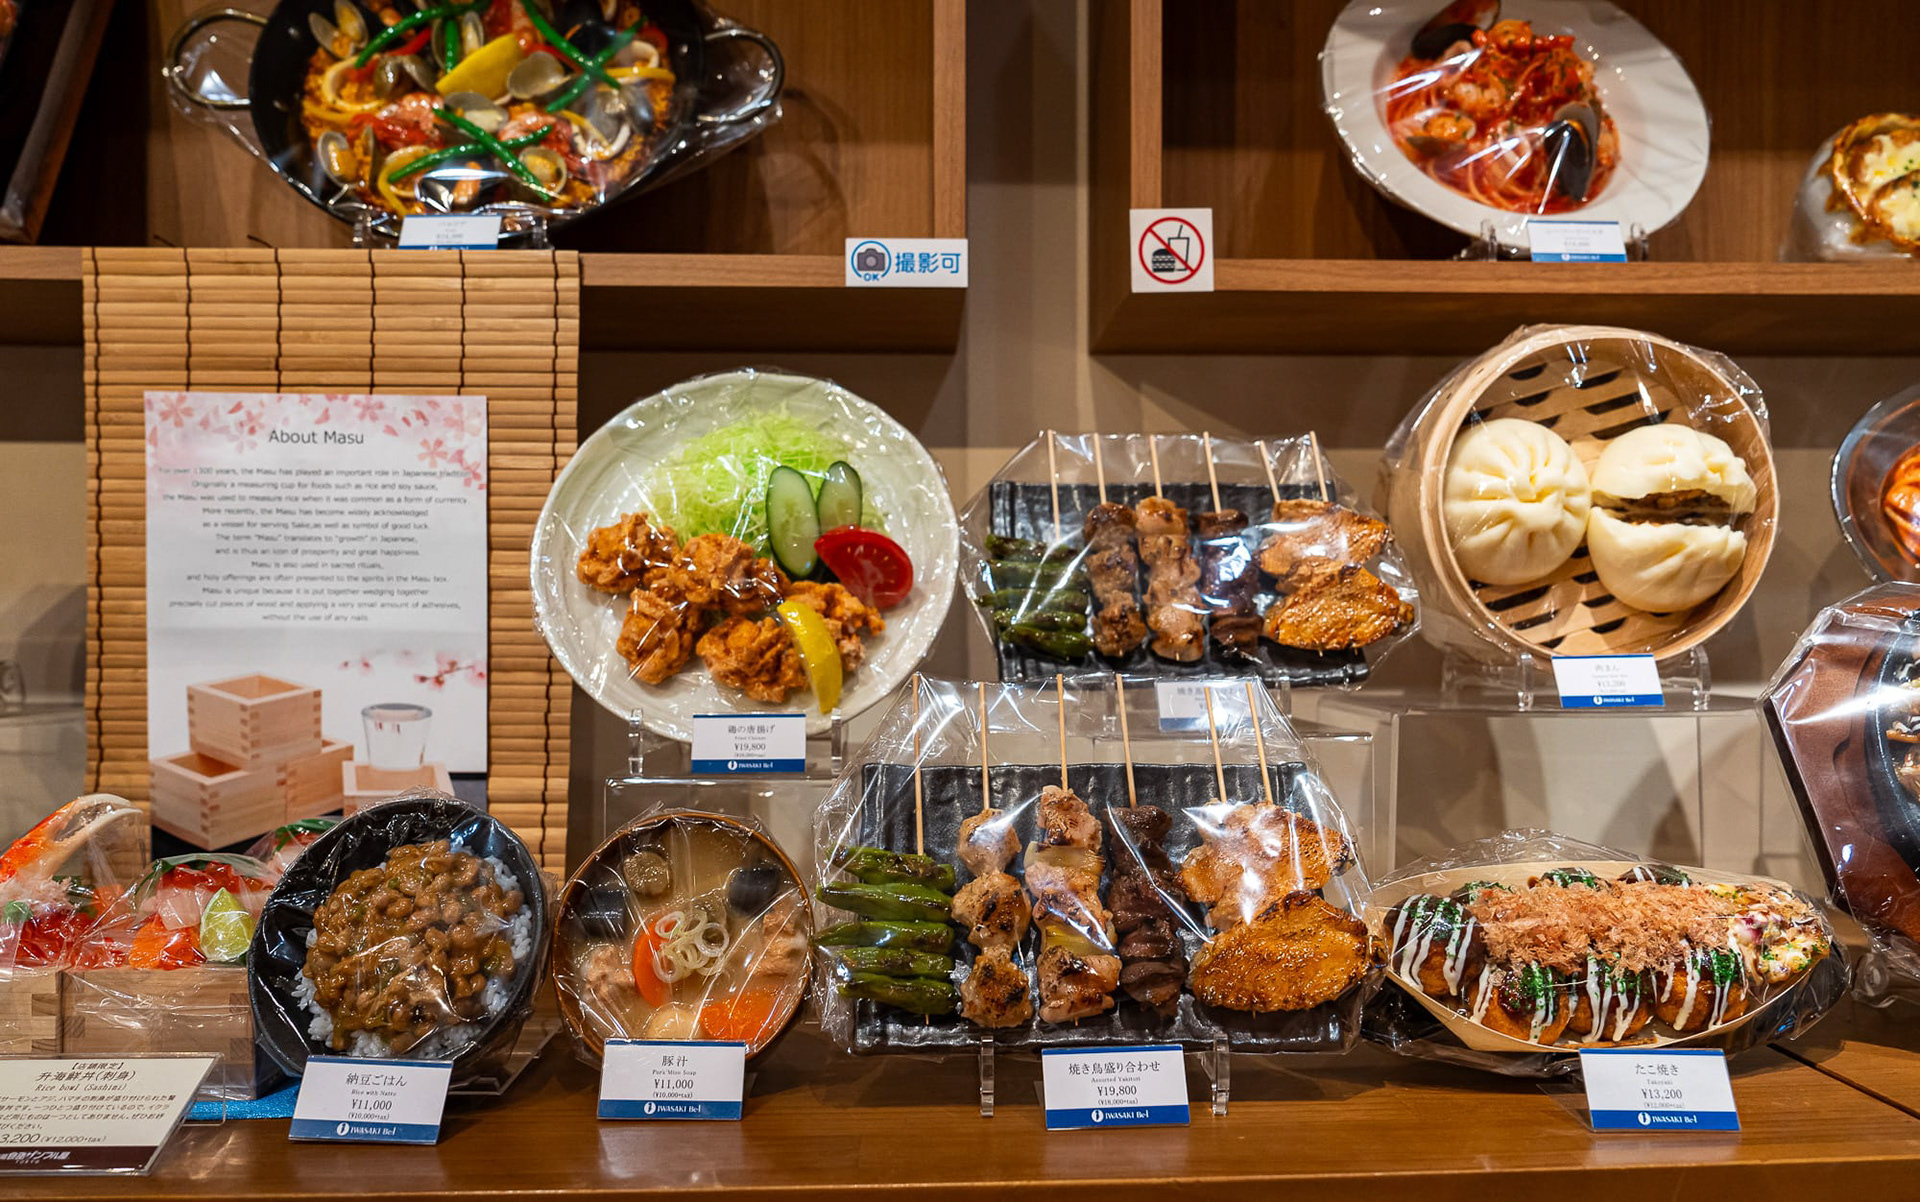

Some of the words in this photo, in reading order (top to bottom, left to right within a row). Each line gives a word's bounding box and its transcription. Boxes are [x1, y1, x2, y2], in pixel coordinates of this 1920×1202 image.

[895, 252, 962, 274] 撮影可
[863, 272, 880, 282] OK
[269, 429, 317, 444] About
[323, 430, 364, 445] Masu
[224, 508, 257, 517] recently,
[373, 510, 428, 519] acknowledged
[734, 743, 766, 751] ¥19,800
[661, 1055, 688, 1067] 豚汁
[1068, 1061, 1161, 1076] 焼き鳥盛り合わせ
[1635, 1063, 1680, 1076] たこ焼き
[345, 1072, 408, 1087] 納豆ごはん
[654, 1079, 694, 1090] ¥11,000
[35, 1083, 57, 1092] Rice
[59, 1083, 80, 1091] bowl
[83, 1083, 128, 1092] (Sashimi)
[1097, 1085, 1137, 1096] ¥19,800
[1641, 1088, 1683, 1100] ¥13,200
[352, 1098, 393, 1111] ¥11,000
[1105, 1111, 1135, 1119] IWASAKI
[1652, 1115, 1683, 1123] IWASAKI
[350, 1126, 381, 1135] IWASAKI
